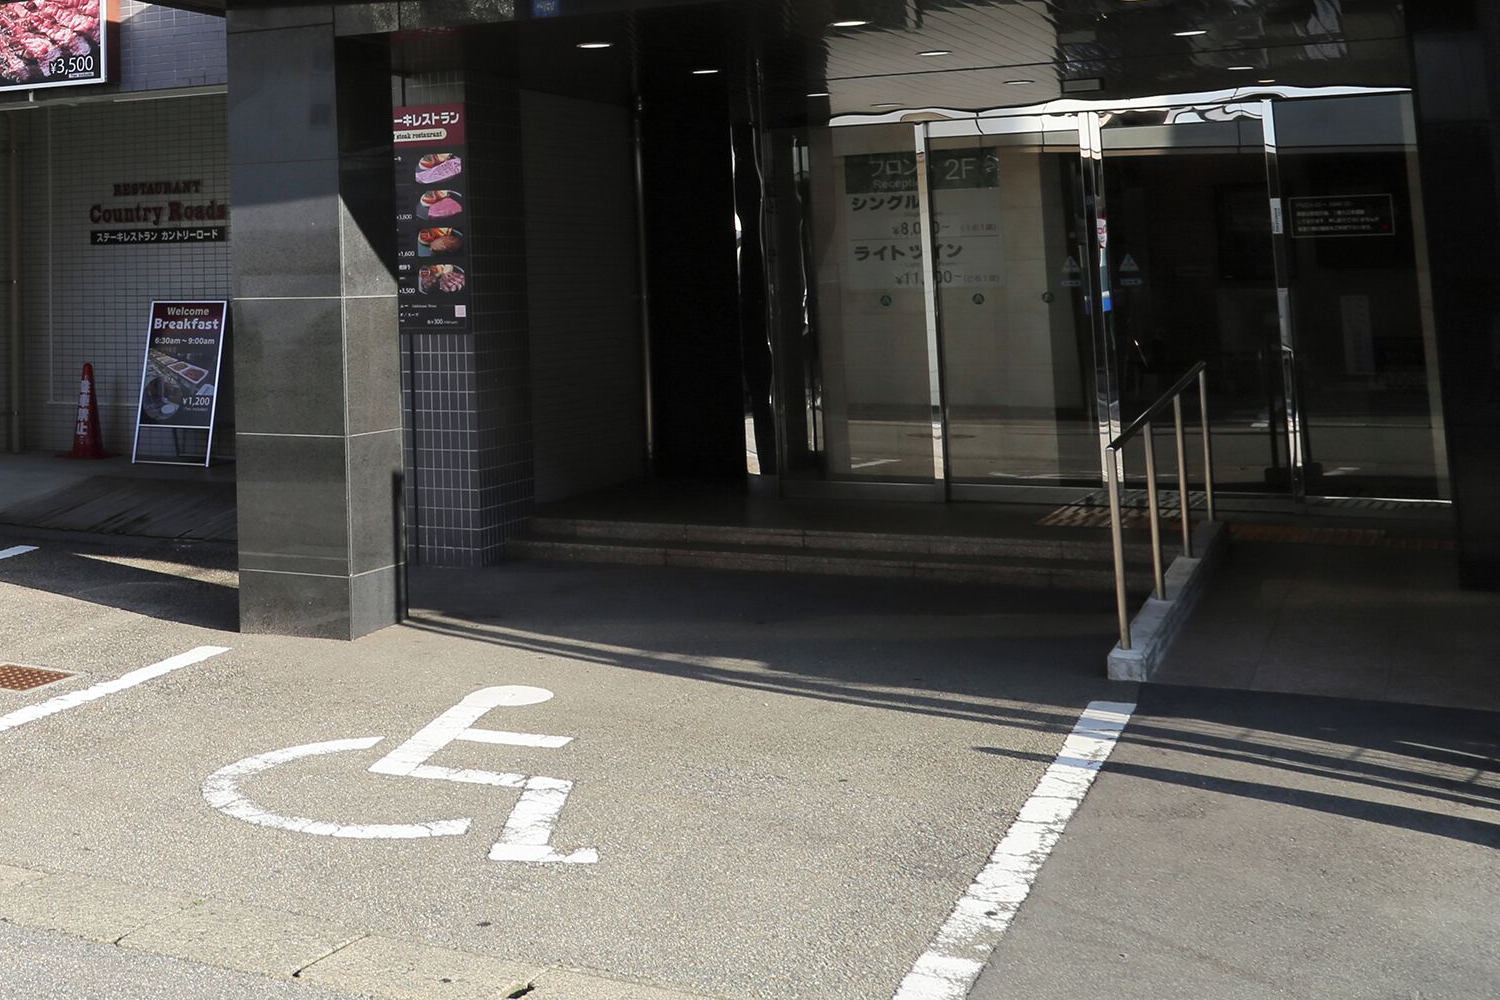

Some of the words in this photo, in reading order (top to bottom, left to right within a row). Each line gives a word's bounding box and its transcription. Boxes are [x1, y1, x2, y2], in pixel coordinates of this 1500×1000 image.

[50, 55, 94, 75] ¥3,500
[945, 157, 976, 181] 2F
[113, 181, 201, 197] RESTAURANT
[89, 203, 164, 226] Country
[167, 200, 227, 222] Roads
[96, 230, 158, 243] ステーキレストラン
[161, 228, 218, 241] カントリーロード
[167, 306, 210, 316] Welcome
[153, 318, 220, 330] Breakfast
[154, 337, 181, 345] 6:30am
[188, 337, 215, 345] 9:00am
[182, 396, 210, 407] ¥1,200
